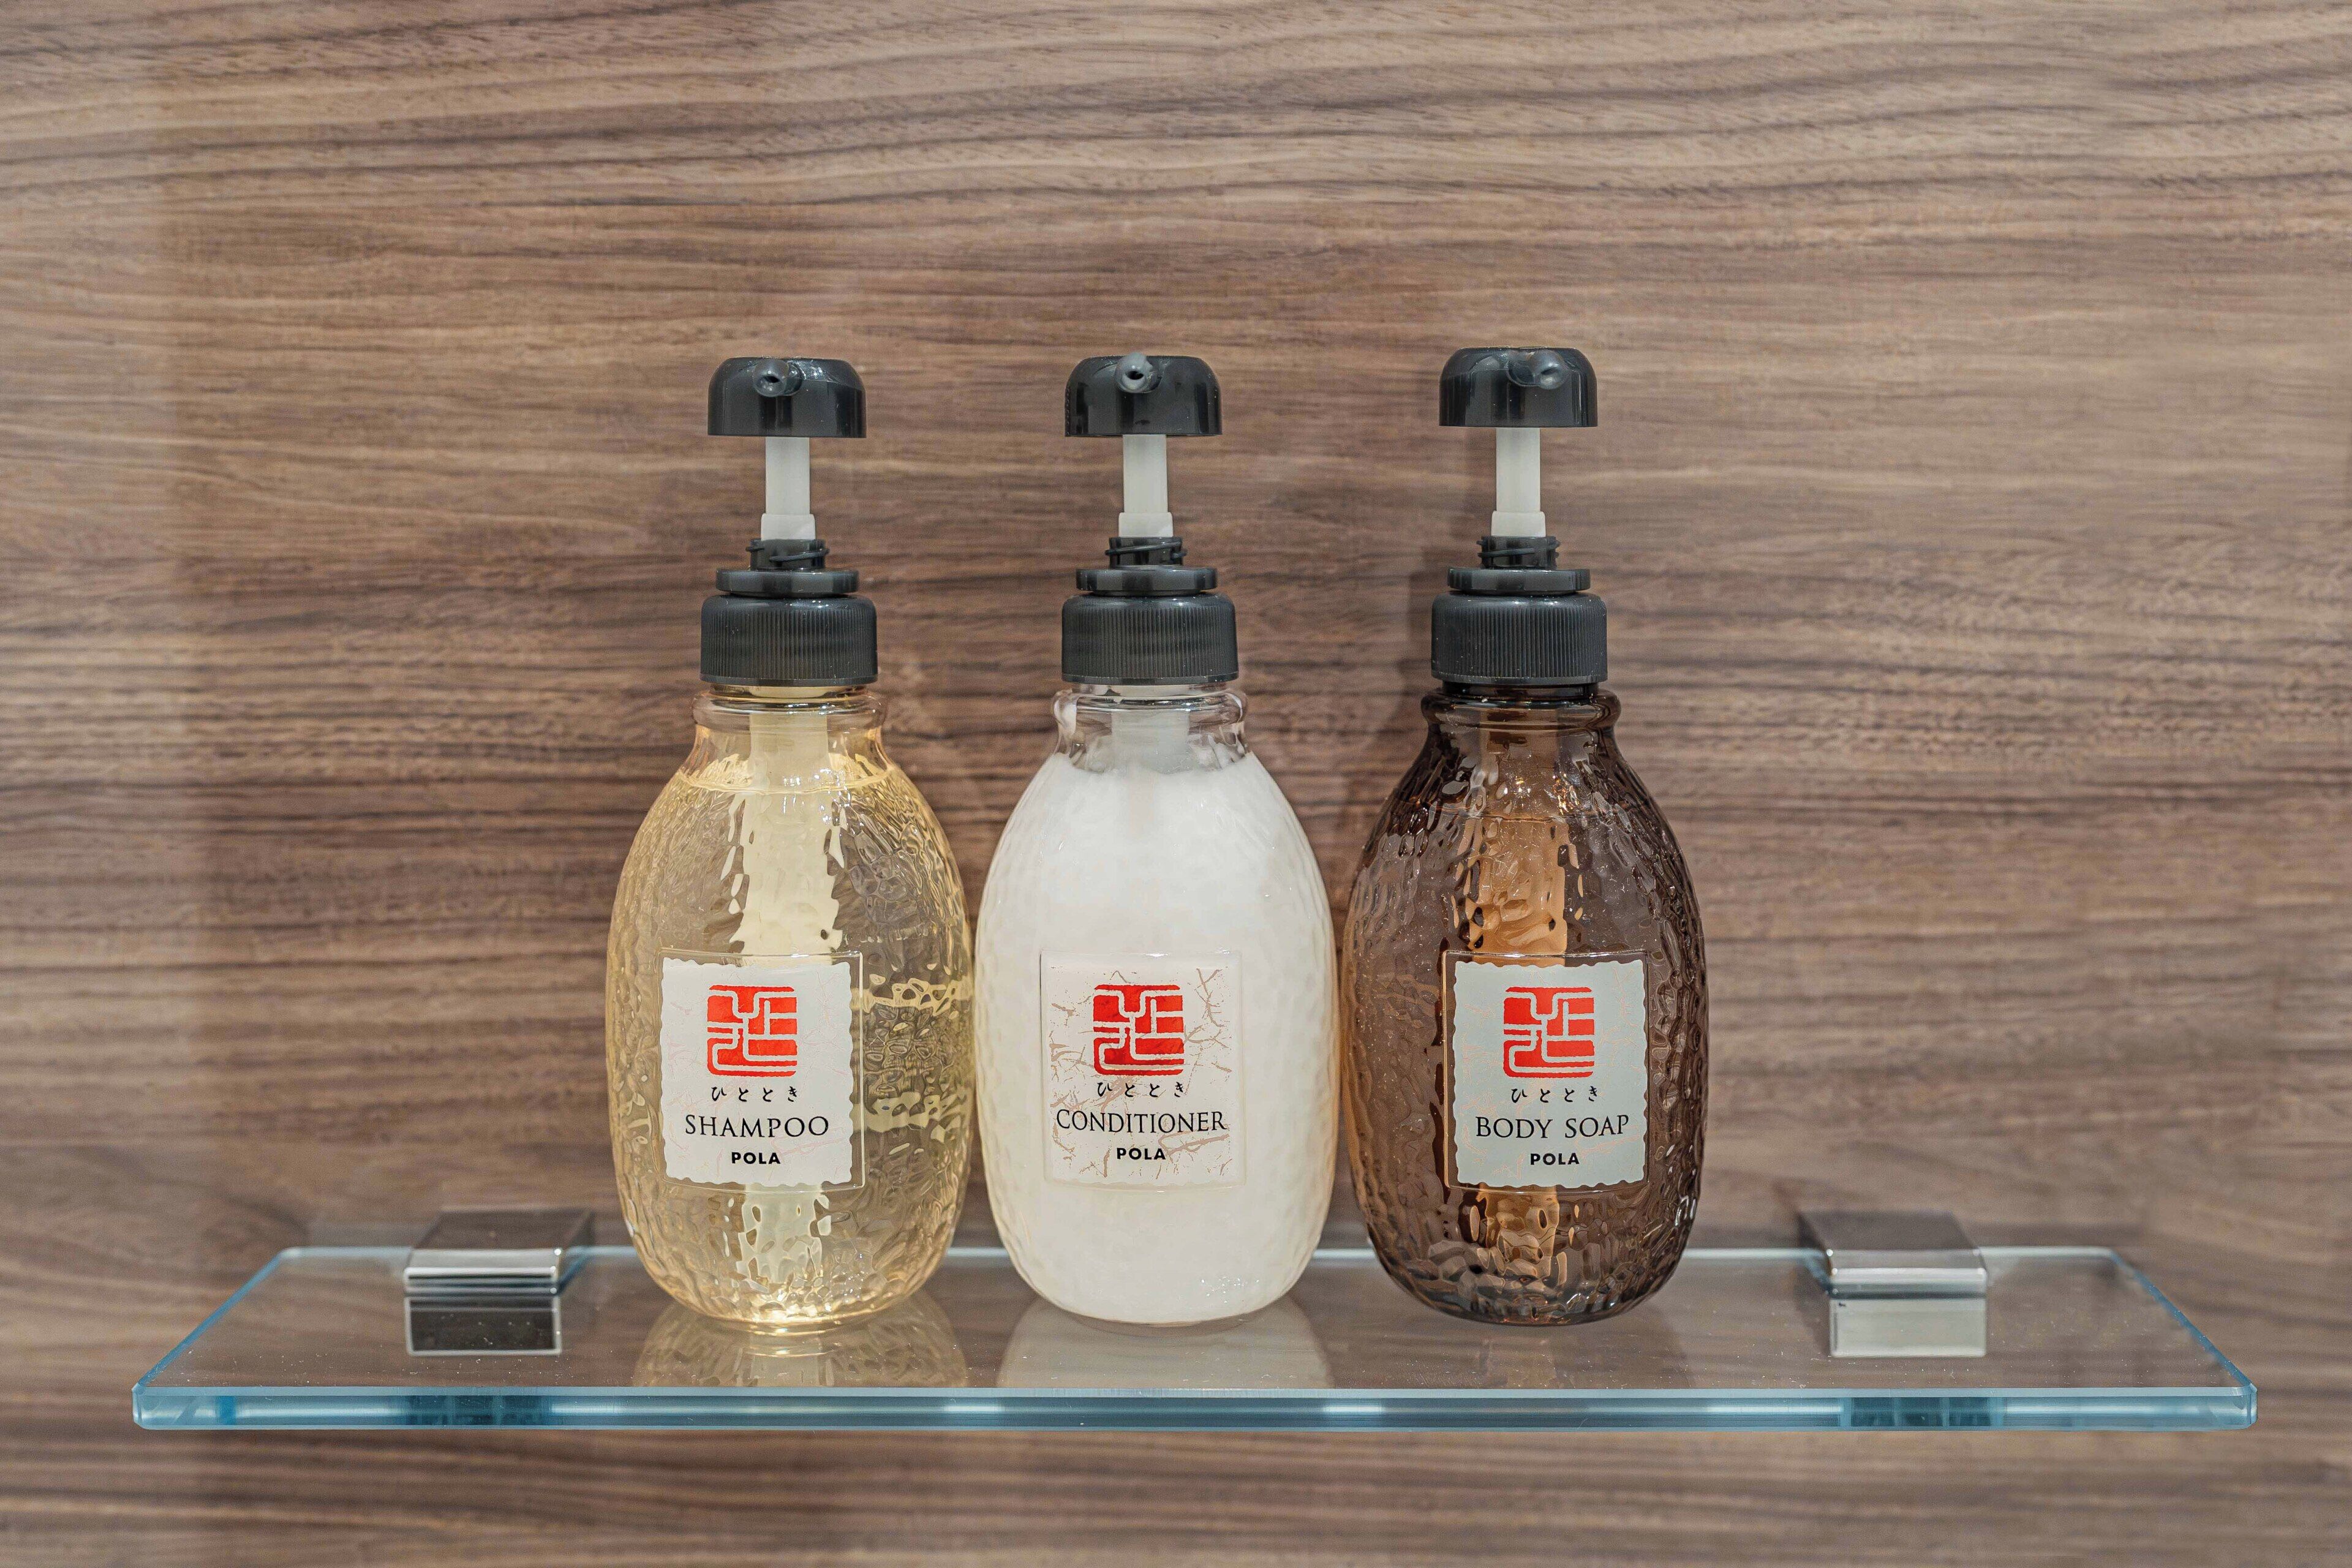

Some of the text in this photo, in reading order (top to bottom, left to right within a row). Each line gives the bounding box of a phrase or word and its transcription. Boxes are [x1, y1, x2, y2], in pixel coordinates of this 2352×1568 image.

[711, 1086, 797, 1102] ひととき
[1097, 1082, 1183, 1098] ひととき
[1511, 1085, 1597, 1104] ひととき
[685, 1114, 829, 1138] SHAMPOO
[1056, 1109, 1227, 1133] CONDITIONER
[1475, 1114, 1629, 1139] BODY SOAP
[731, 1152, 781, 1164] POLA
[1117, 1147, 1166, 1160] POLA
[1530, 1152, 1580, 1166] POLA
